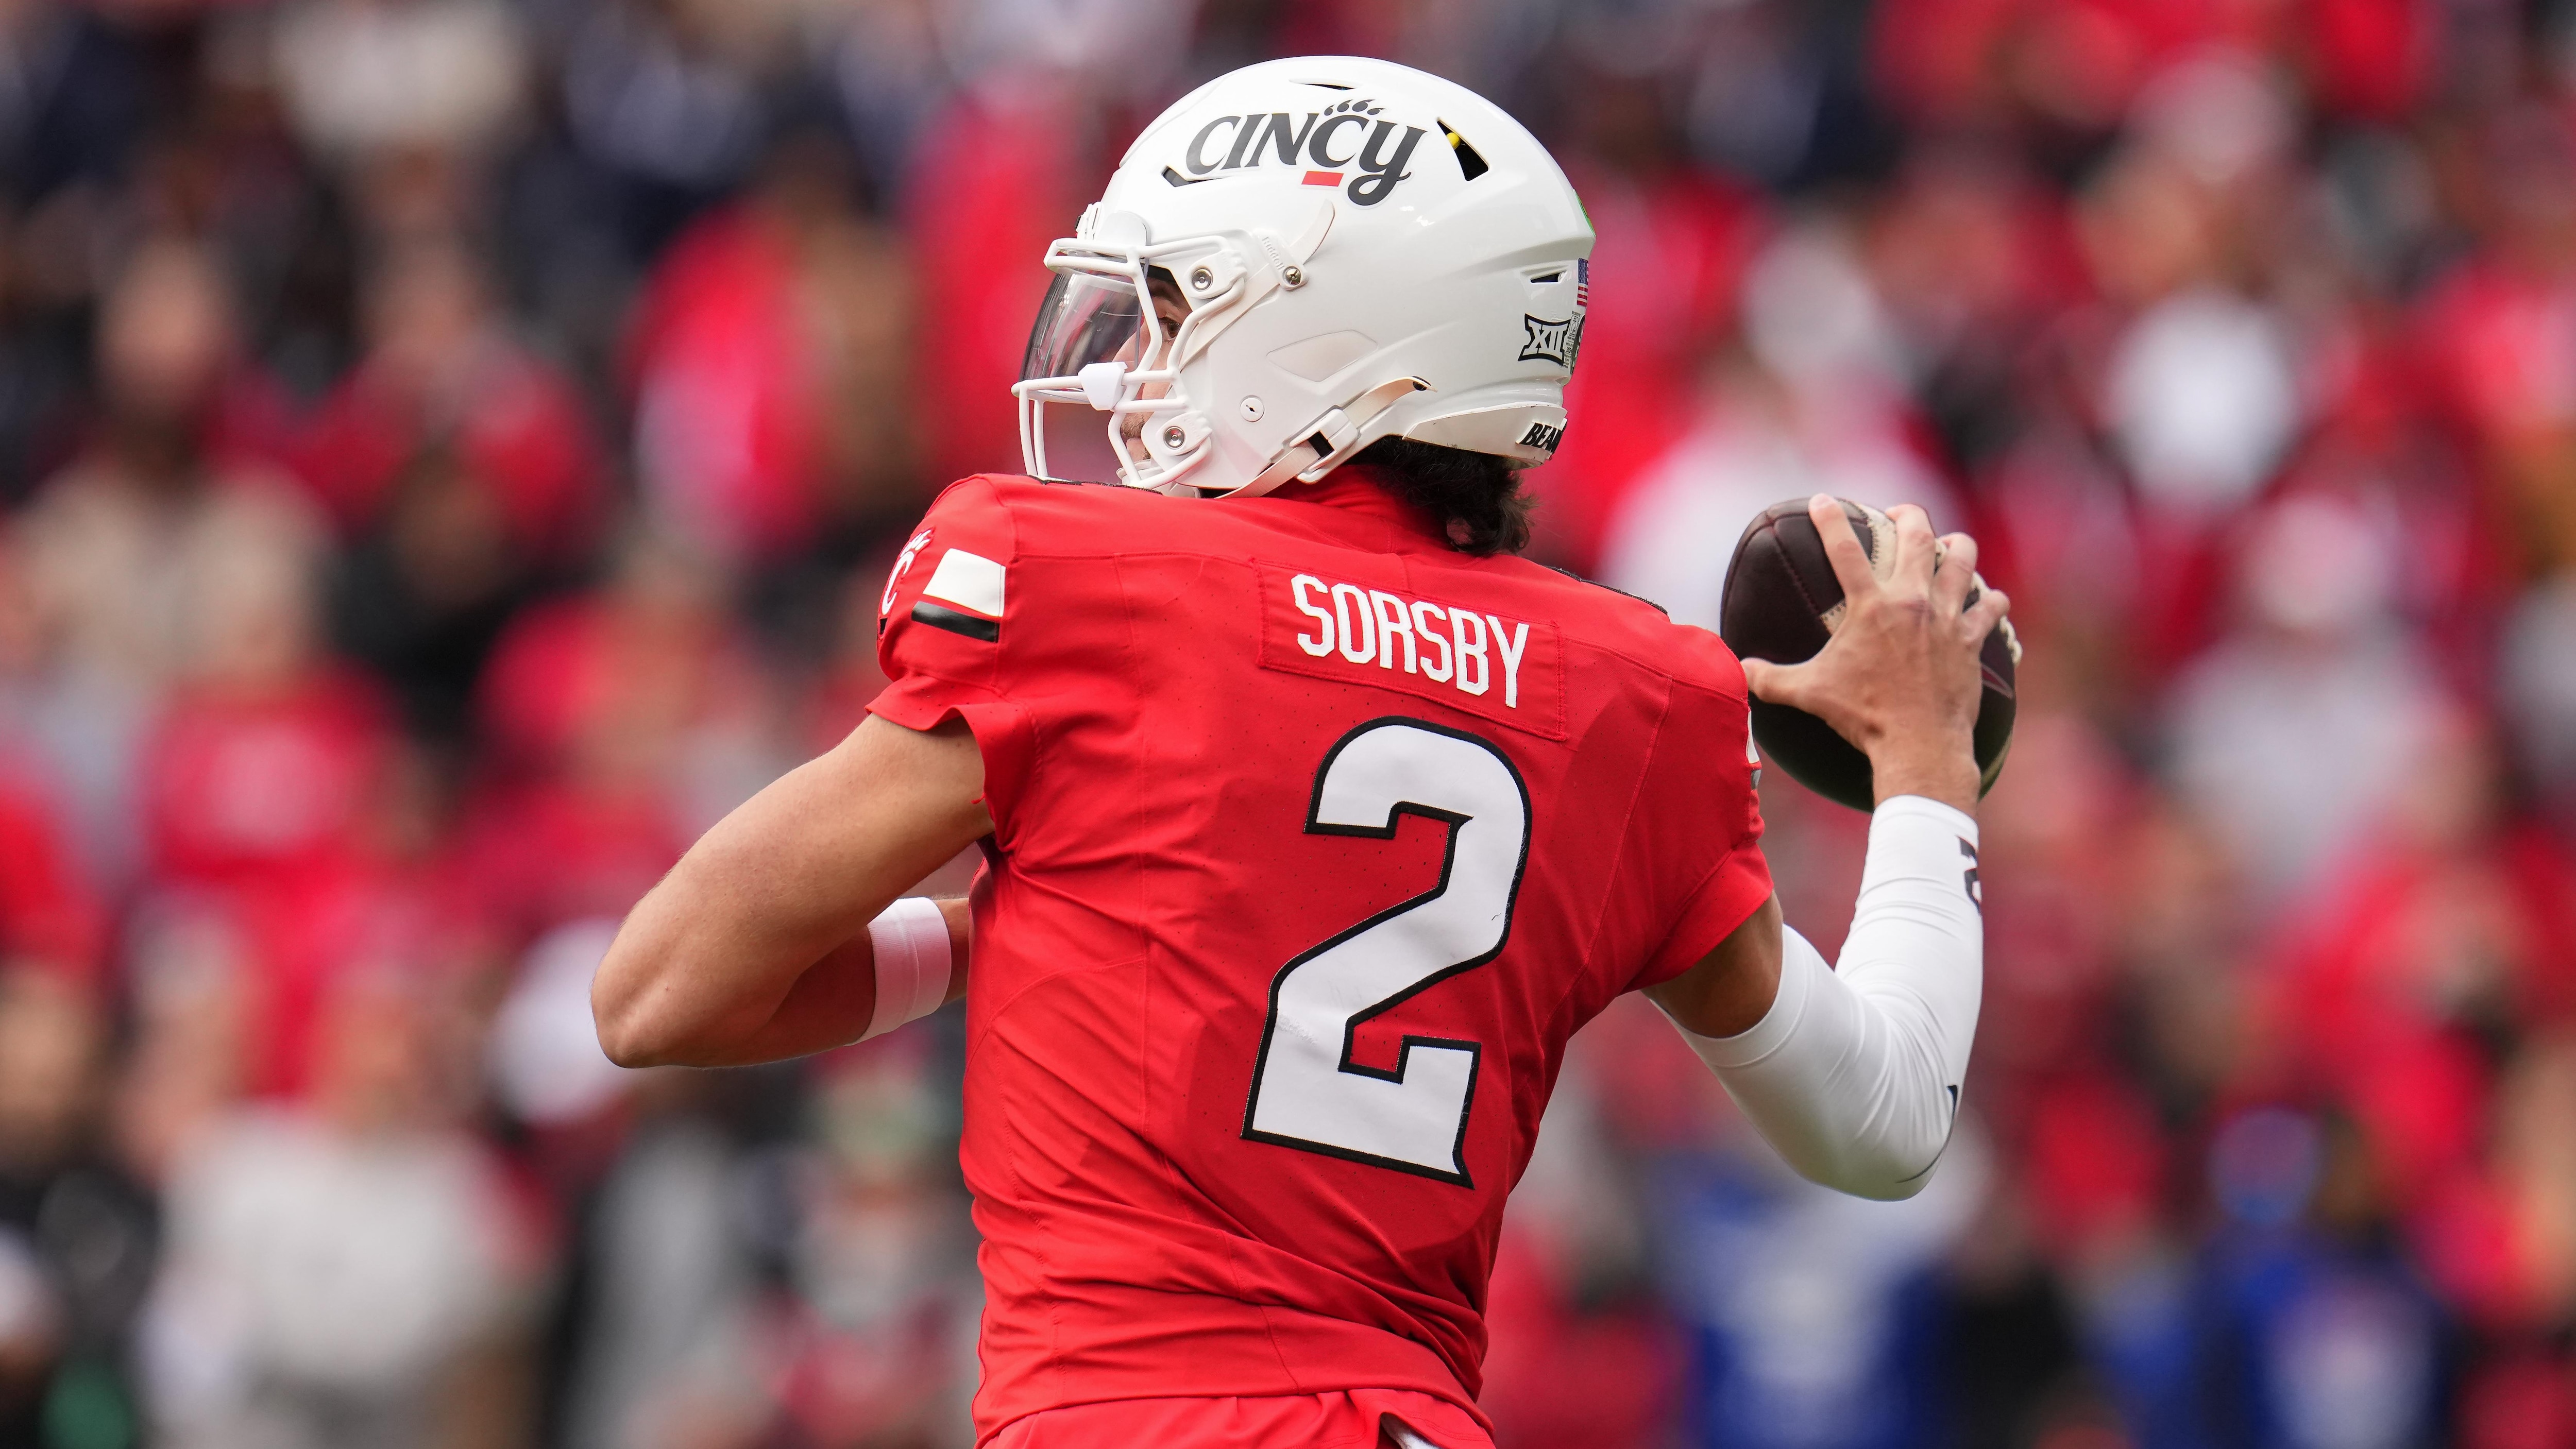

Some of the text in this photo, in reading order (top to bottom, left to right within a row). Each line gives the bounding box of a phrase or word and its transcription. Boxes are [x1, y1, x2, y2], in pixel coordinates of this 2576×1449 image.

[1519, 422, 1564, 454] BEA
[1291, 574, 1530, 708] SORSBY
[1239, 715, 1533, 1189] 2
